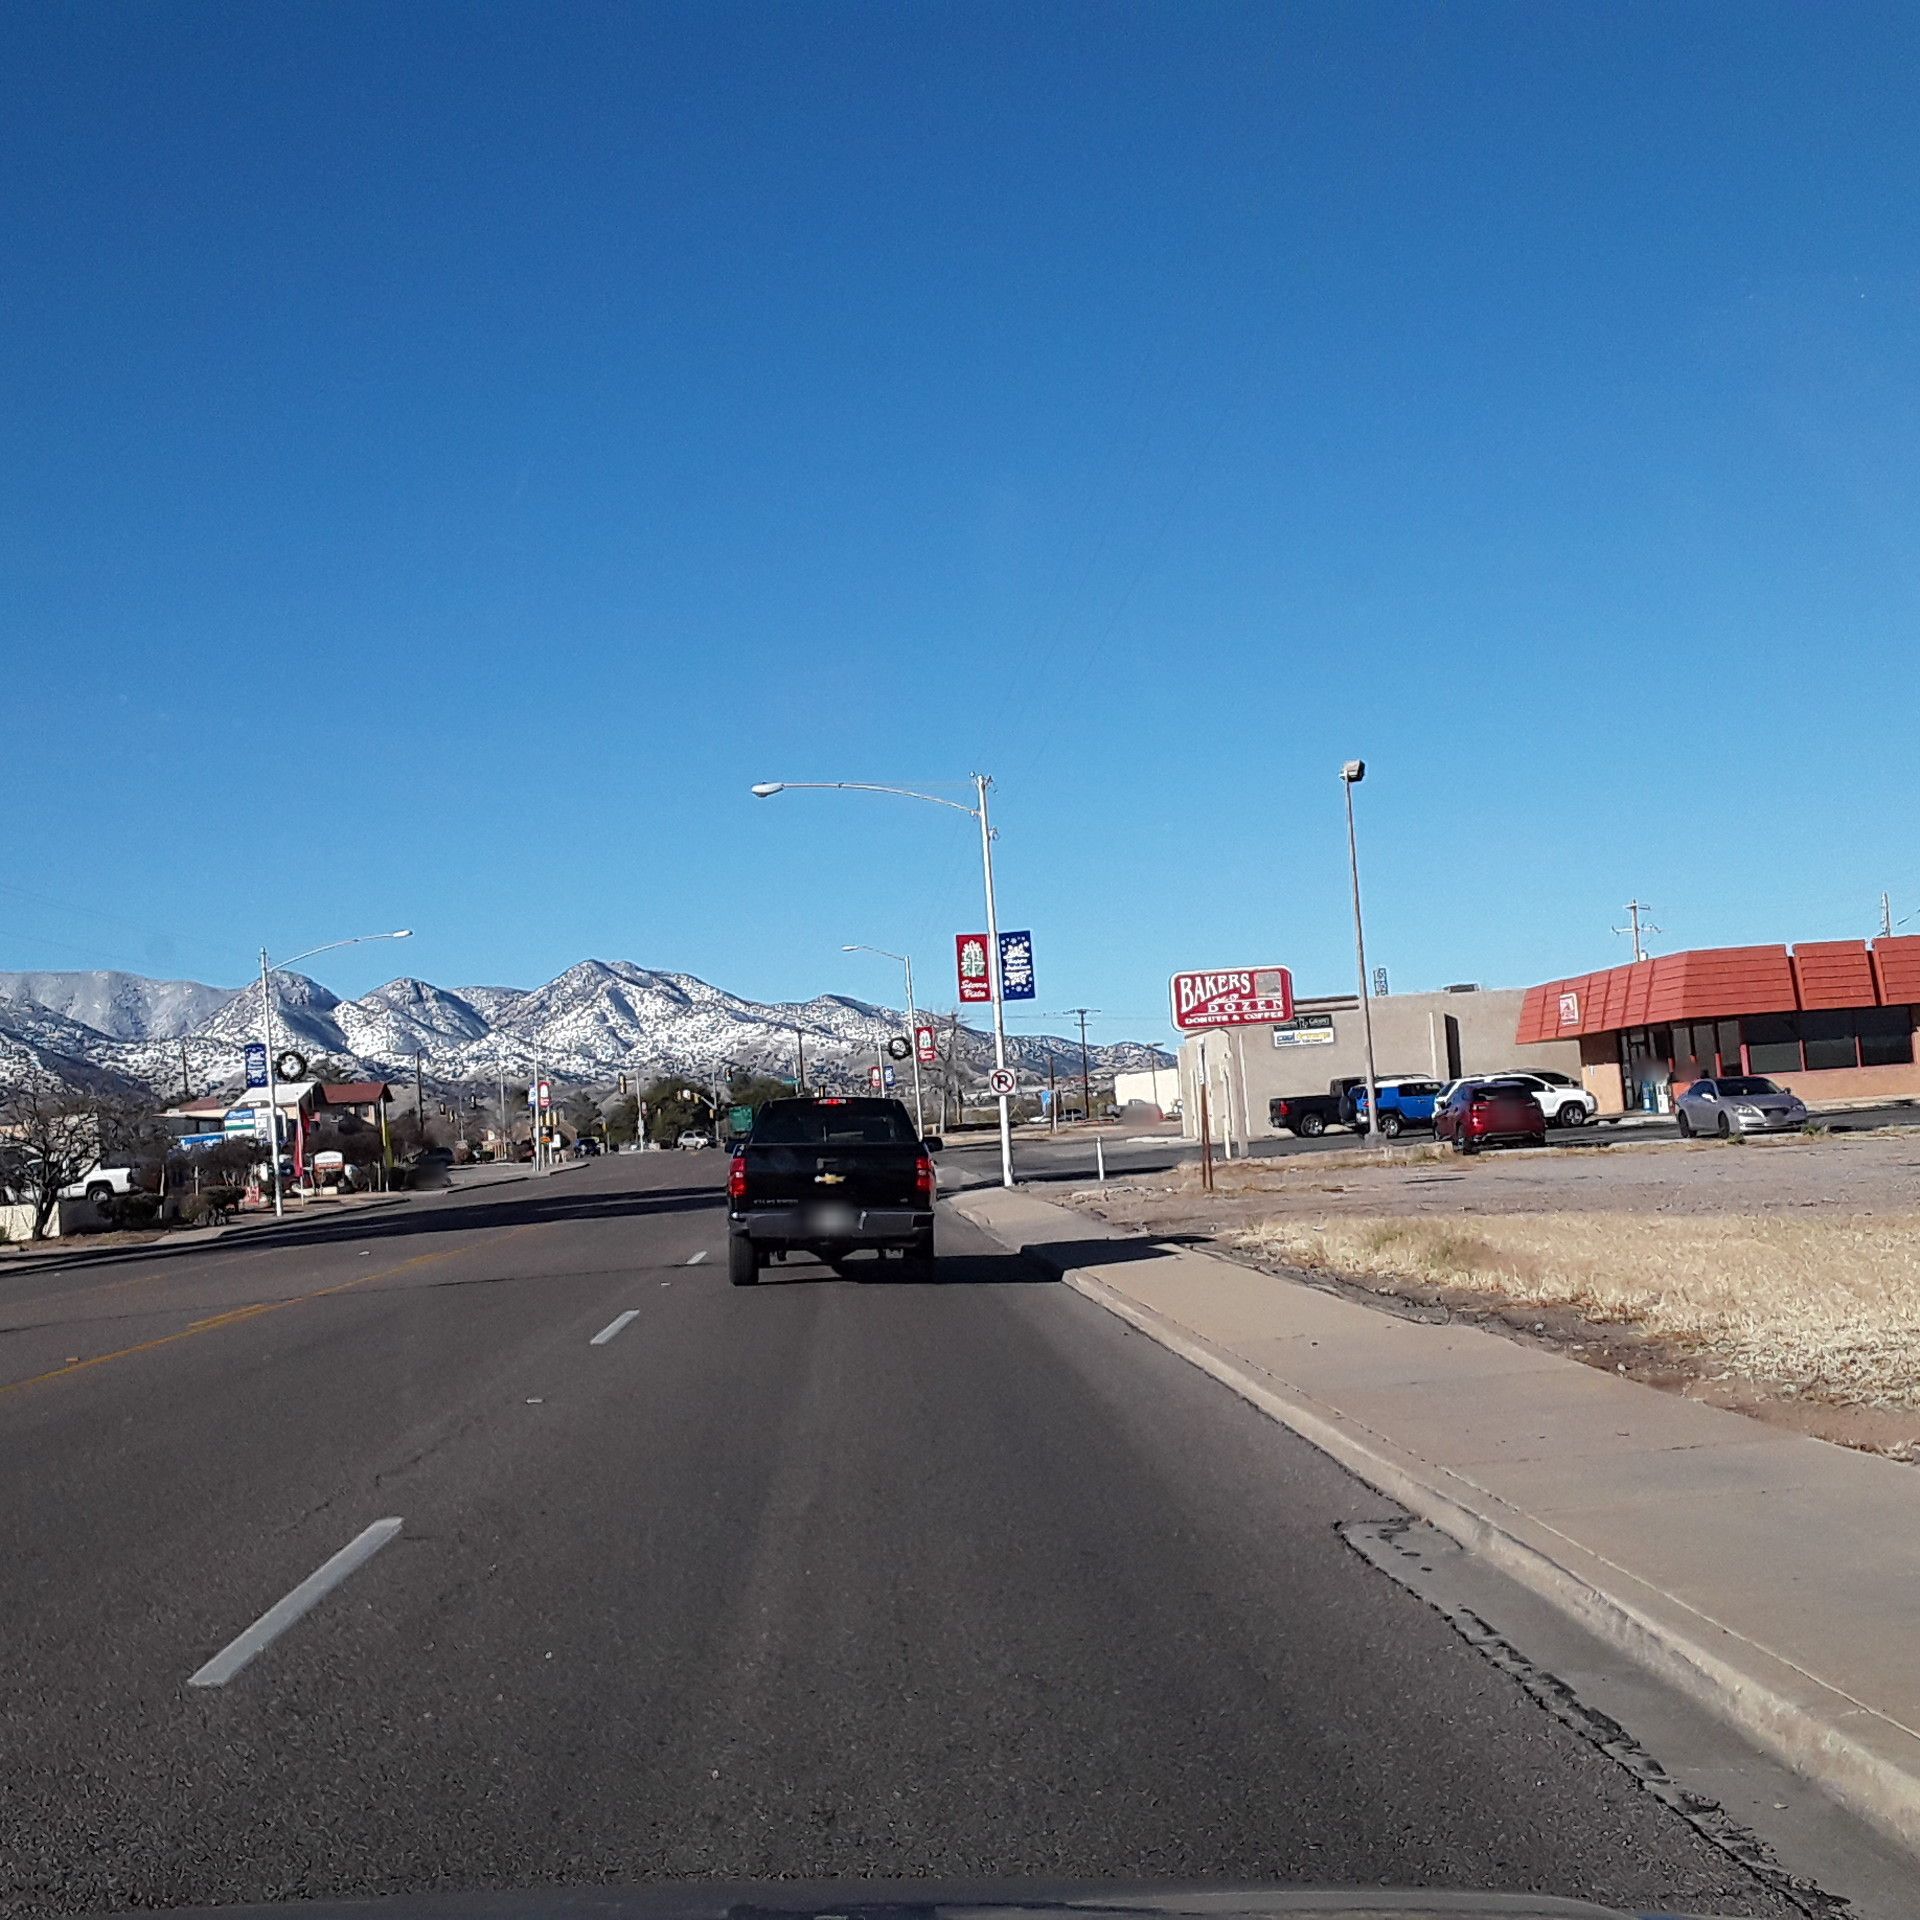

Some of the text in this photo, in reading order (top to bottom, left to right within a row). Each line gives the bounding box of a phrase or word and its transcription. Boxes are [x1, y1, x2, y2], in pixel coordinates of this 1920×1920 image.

[1179, 973, 1251, 1014] BAKERS
[1208, 999, 1284, 1013] DOZEN
[1185, 1015, 1229, 1025] DONUTS
[1243, 1011, 1285, 1021] COFFEE
